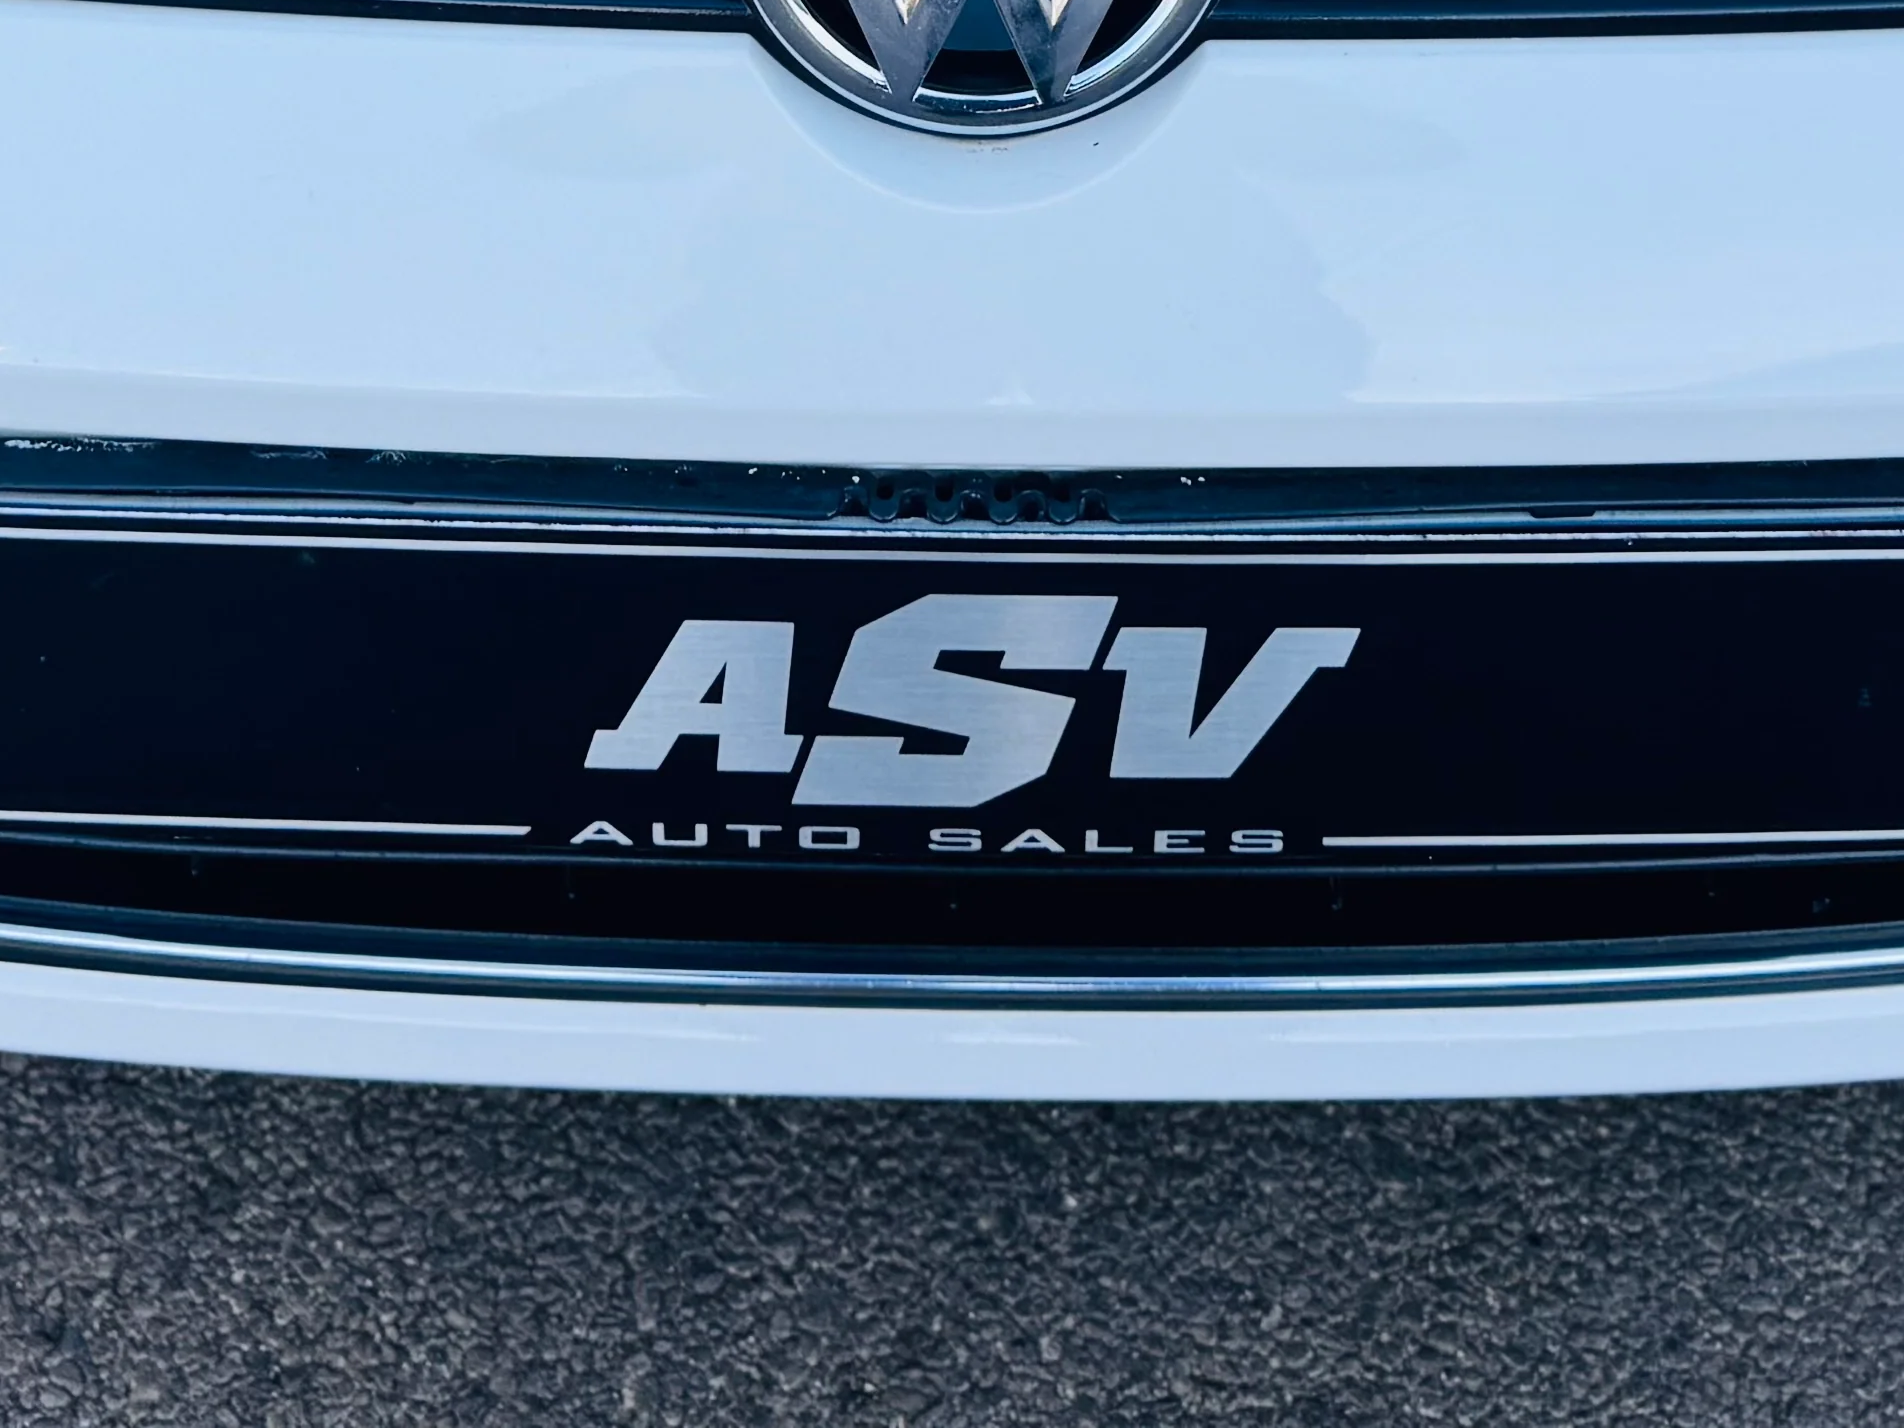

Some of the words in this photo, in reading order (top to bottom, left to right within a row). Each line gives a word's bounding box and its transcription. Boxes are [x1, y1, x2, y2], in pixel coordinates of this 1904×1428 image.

[583, 593, 1362, 809] ASV
[569, 819, 862, 850] AUTO
[927, 827, 1286, 855] SALES
